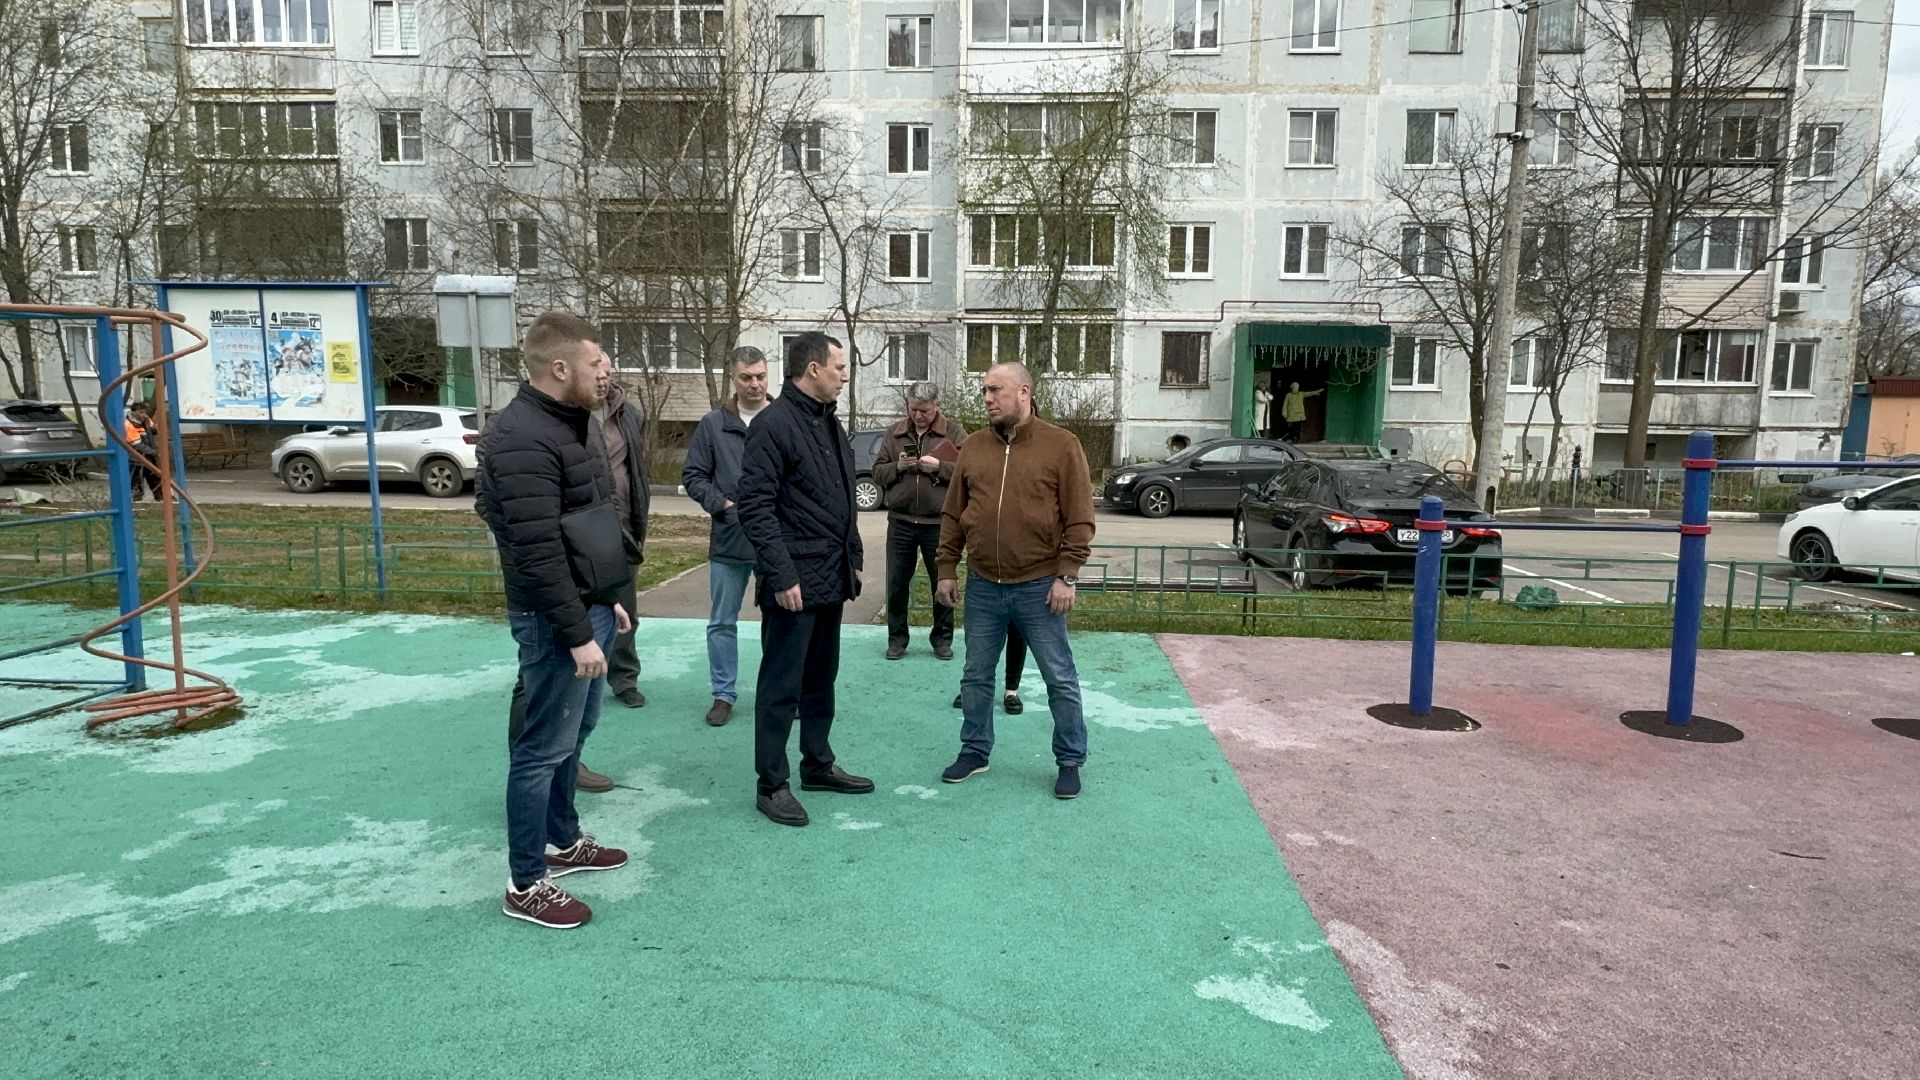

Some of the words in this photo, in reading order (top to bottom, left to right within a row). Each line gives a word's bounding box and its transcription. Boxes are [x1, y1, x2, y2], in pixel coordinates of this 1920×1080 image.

[210, 310, 222, 322] 30
[270, 312, 278, 324] 4
[575, 847, 597, 864] N
[523, 895, 549, 918] N
